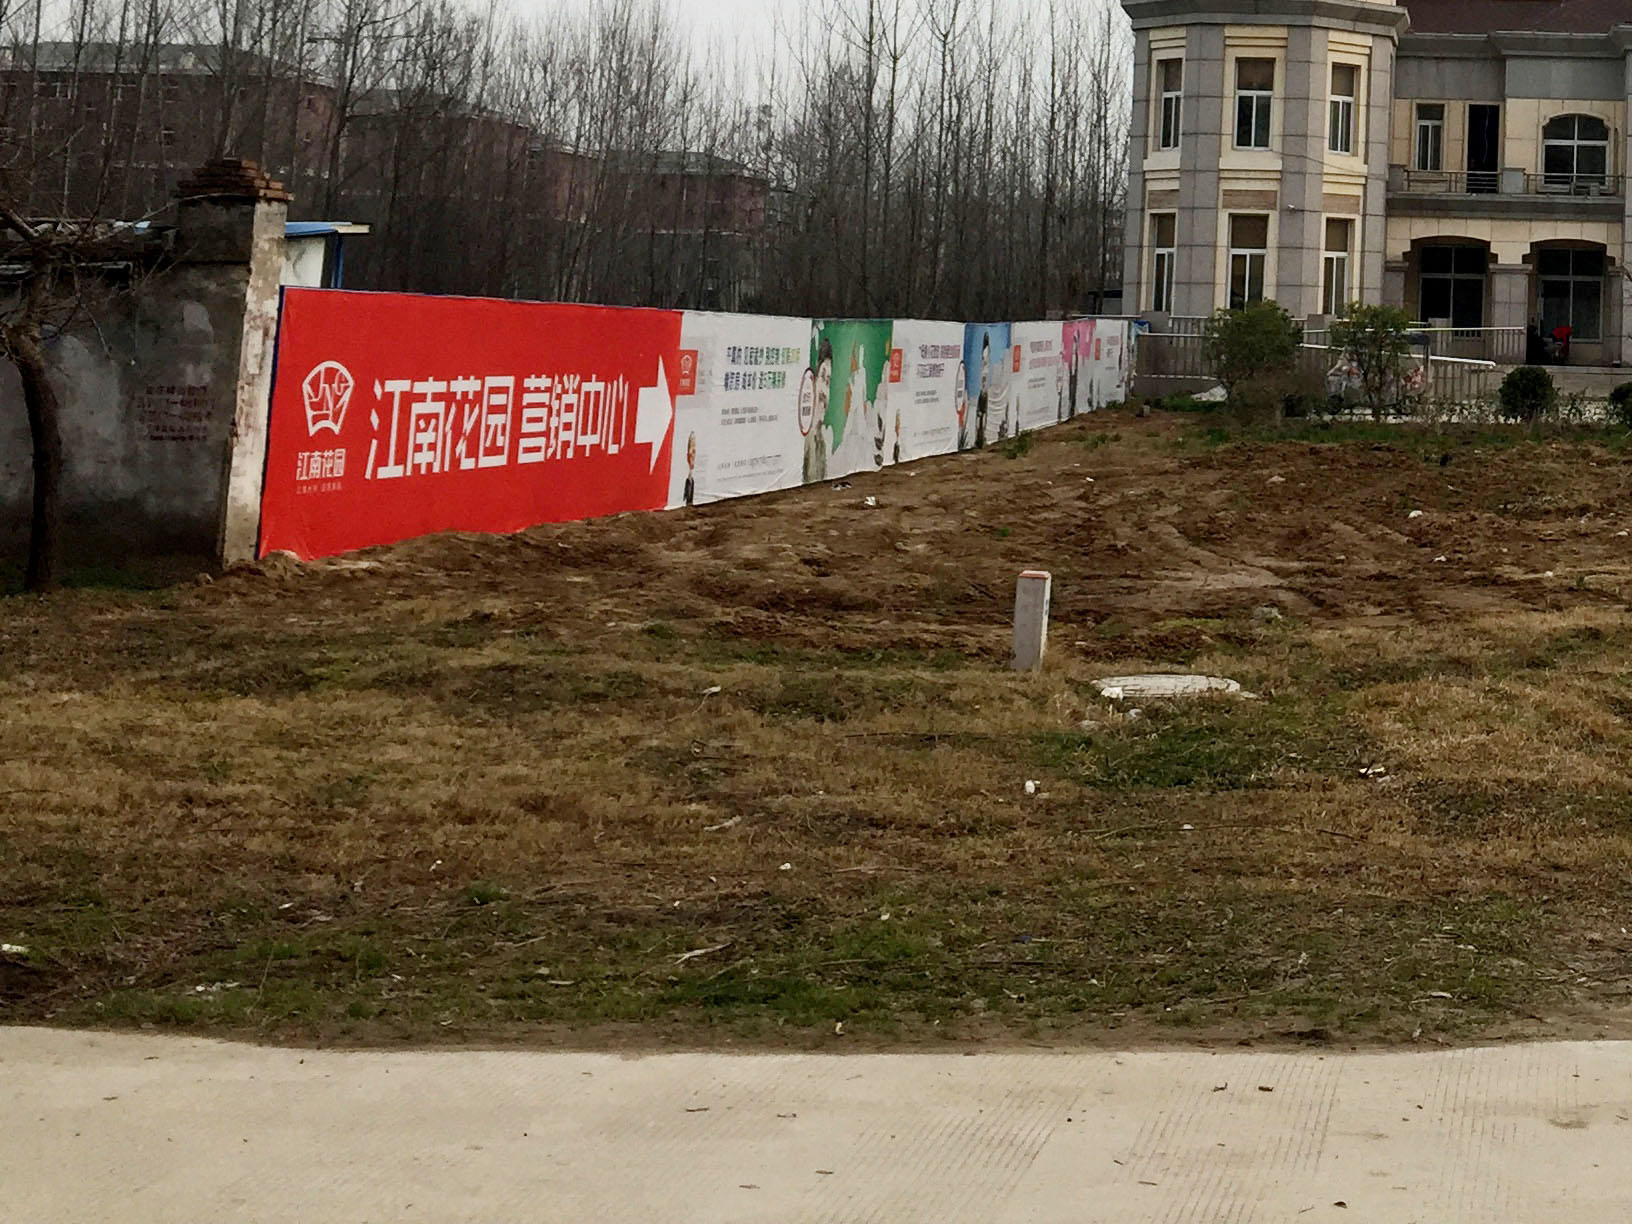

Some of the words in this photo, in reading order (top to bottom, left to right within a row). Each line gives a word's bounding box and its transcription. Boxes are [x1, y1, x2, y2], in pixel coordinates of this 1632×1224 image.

[365, 375, 515, 480] 江南花园
[517, 373, 629, 464] 营销中心
[296, 449, 346, 480] 江南花园
